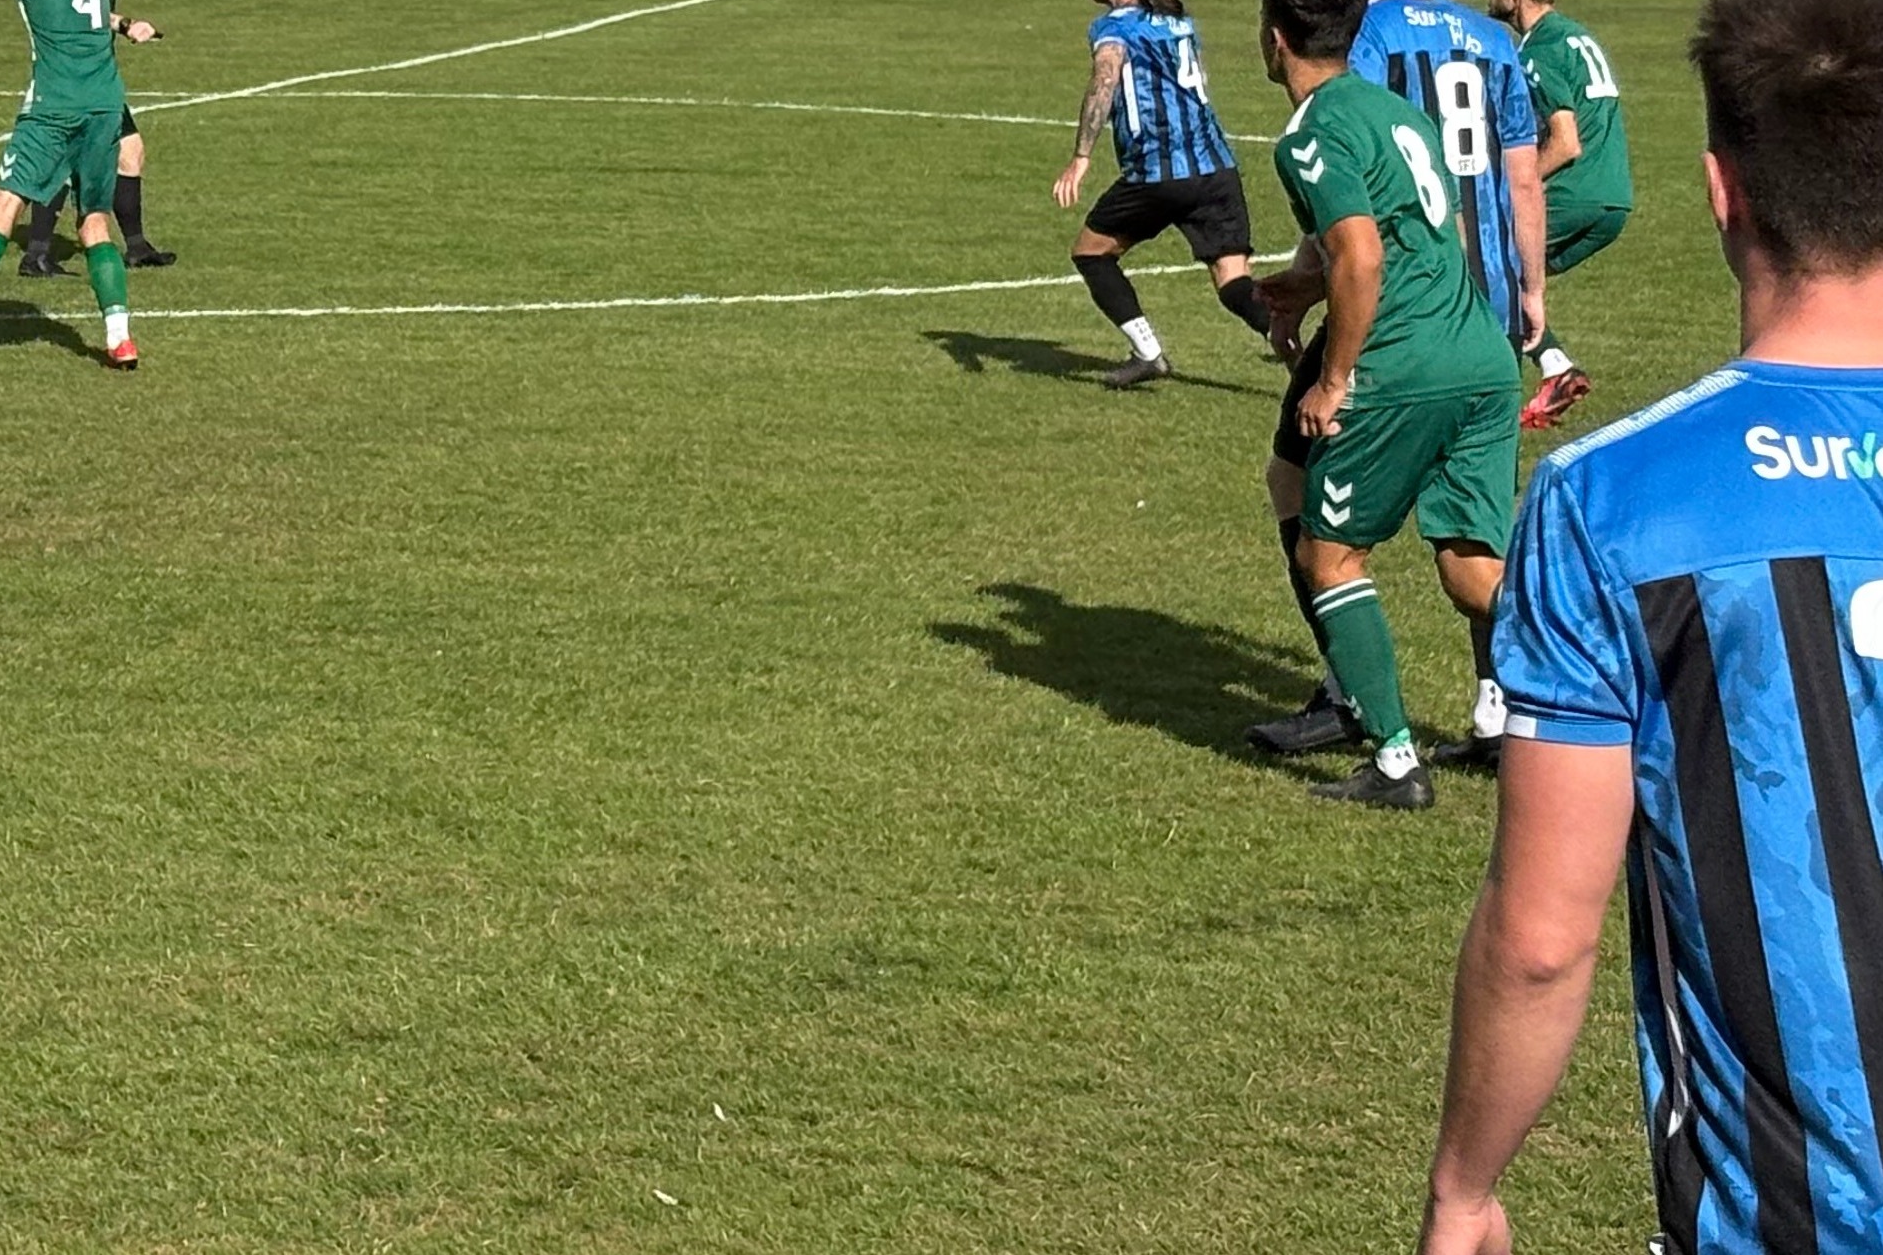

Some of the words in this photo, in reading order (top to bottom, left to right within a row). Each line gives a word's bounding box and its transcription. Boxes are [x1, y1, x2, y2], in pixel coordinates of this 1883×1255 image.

[1178, 37, 1208, 104] 4
[1566, 35, 1619, 99] 11
[1435, 61, 1488, 176] 8
[1391, 123, 1448, 229] 8
